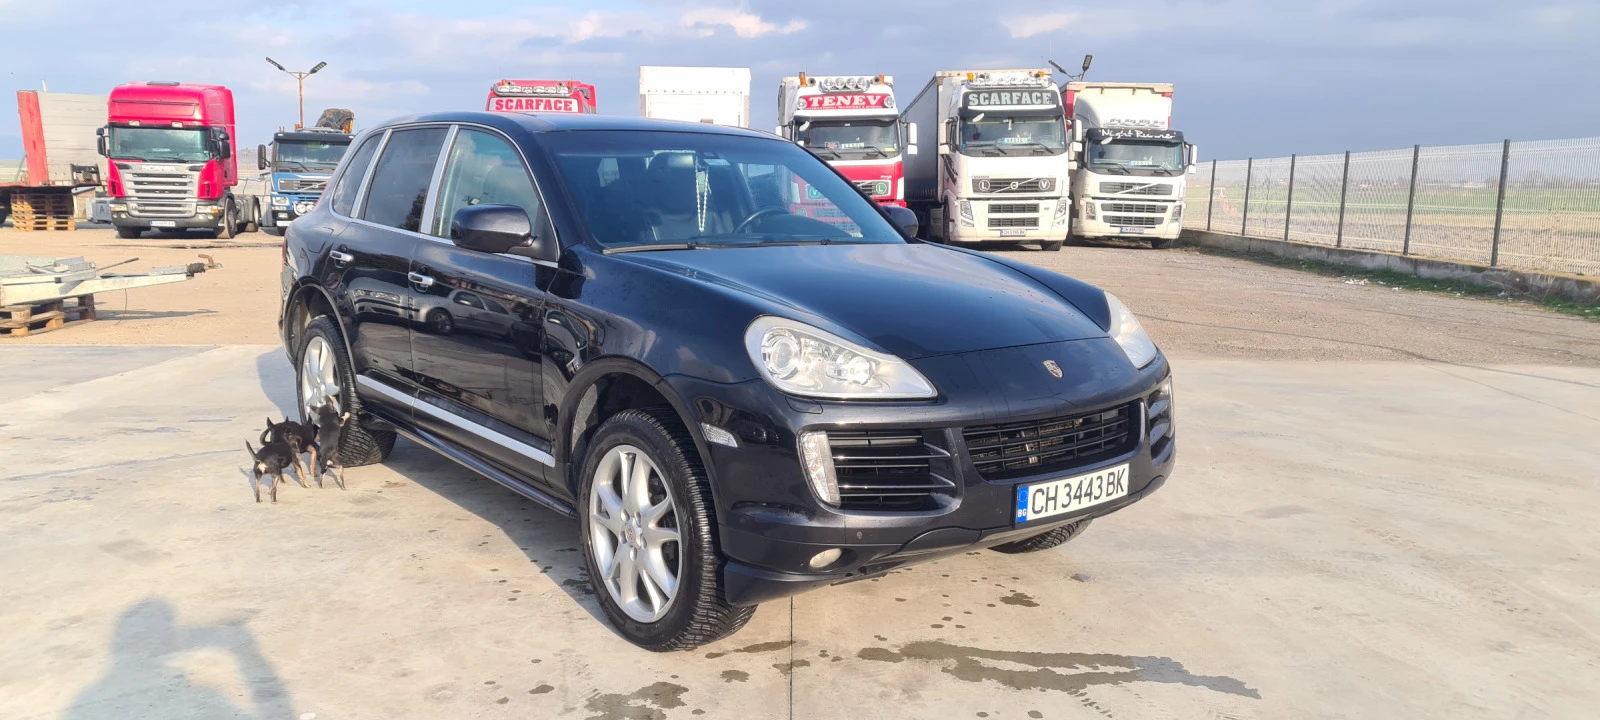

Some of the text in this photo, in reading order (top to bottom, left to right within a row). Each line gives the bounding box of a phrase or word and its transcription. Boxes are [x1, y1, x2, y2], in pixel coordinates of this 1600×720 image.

[495, 98, 573, 111] SCARFACE
[809, 95, 881, 107] TENEV
[968, 92, 1052, 106] SCARFACE
[1031, 467, 1126, 515] CH 3443 BK
[1017, 508, 1027, 518] BG
